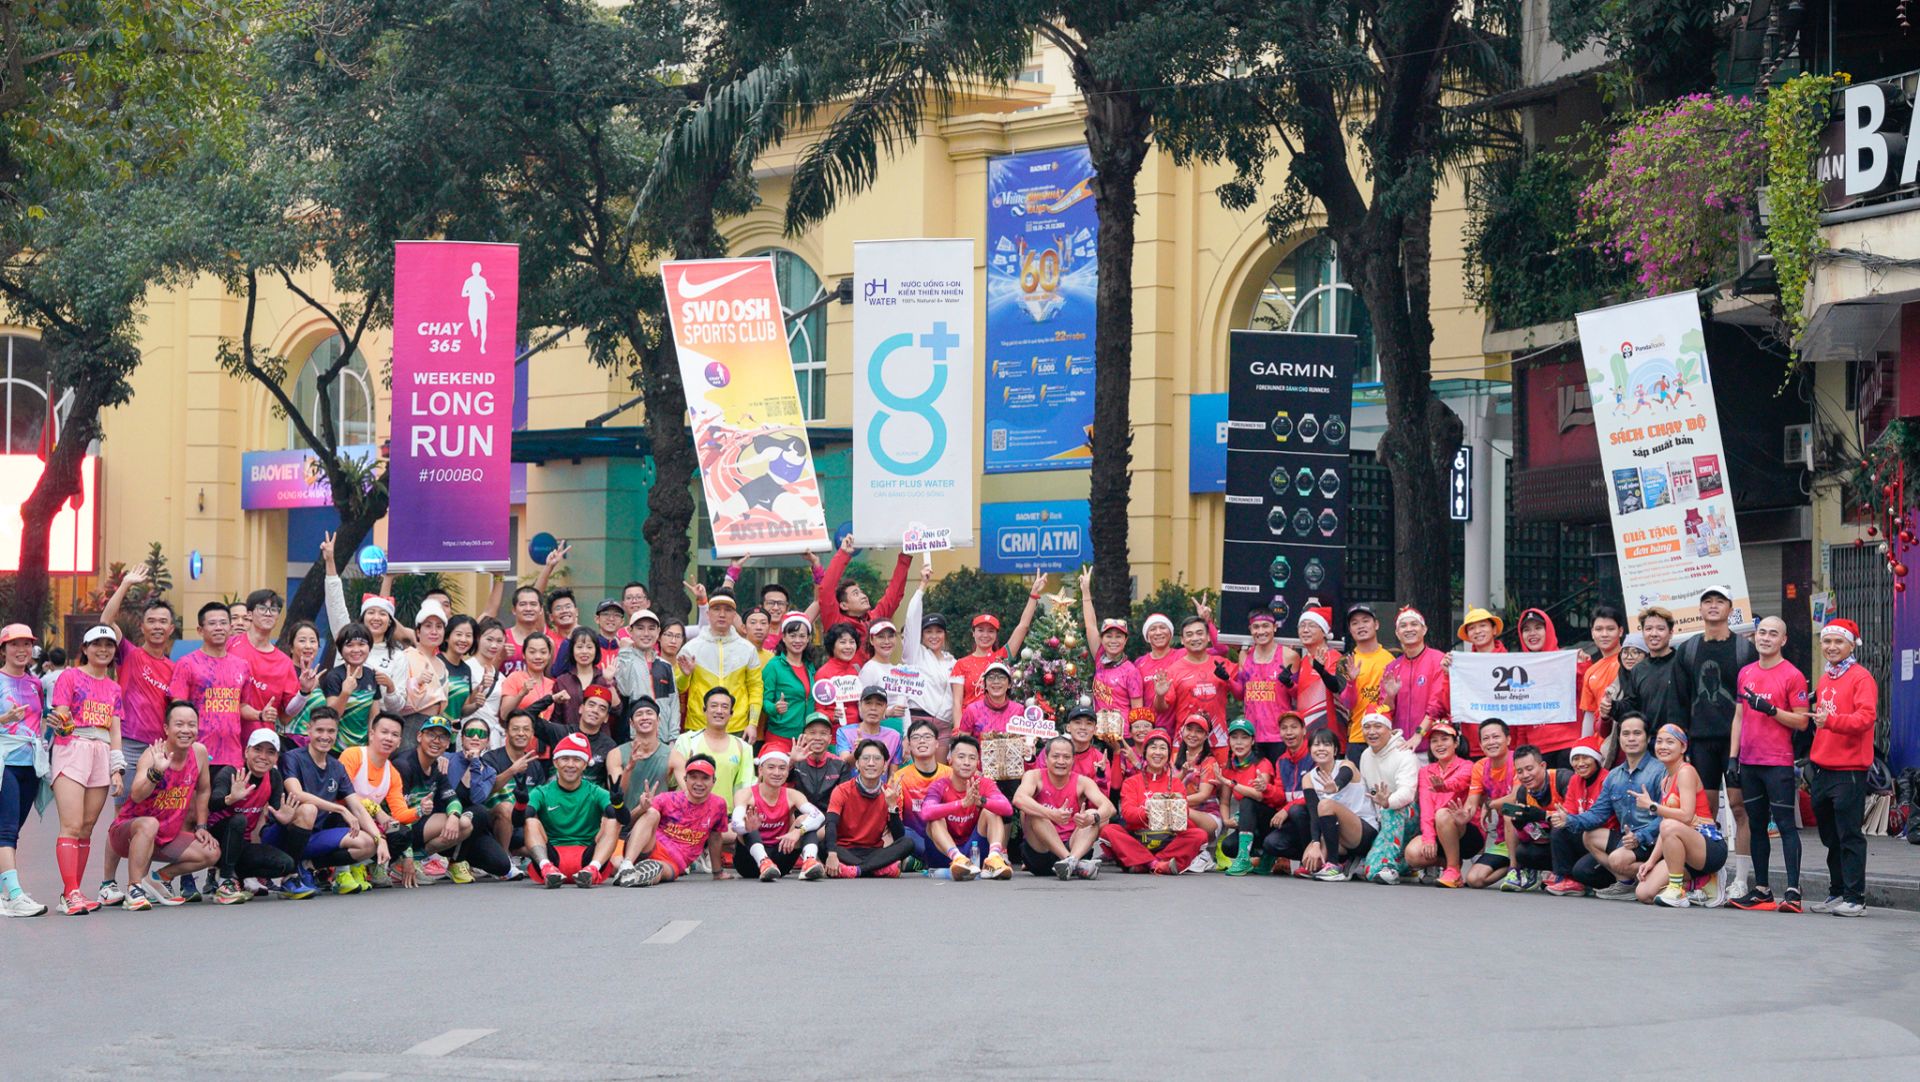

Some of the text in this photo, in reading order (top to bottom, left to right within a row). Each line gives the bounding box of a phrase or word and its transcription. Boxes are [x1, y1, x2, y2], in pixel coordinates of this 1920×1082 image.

[1020, 248, 1060, 293] 60
[682, 298, 770, 324] SWOOSH
[417, 322, 464, 336] CHAY
[684, 321, 777, 345] SPORTS CLUB
[429, 339, 461, 352] 365
[413, 372, 496, 384] WEEKEND
[411, 391, 494, 415] LONG
[1609, 413, 1707, 446] SÁCH CHẠY BỘ
[411, 425, 493, 457] RUN
[251, 464, 300, 482] BAOVIET
[419, 468, 483, 482] #1000BQ
[870, 479, 955, 488] EIGHT PLUS WATER
[729, 522, 764, 541] JUST
[768, 520, 793, 538] DO
[1623, 524, 1678, 544] QUÀ TẶNG
[1001, 532, 1036, 553] CRM
[1041, 531, 1077, 551] ATM
[1492, 666, 1528, 691] 20
[213, 688, 233, 698] YEARS
[905, 686, 923, 696] Pro
